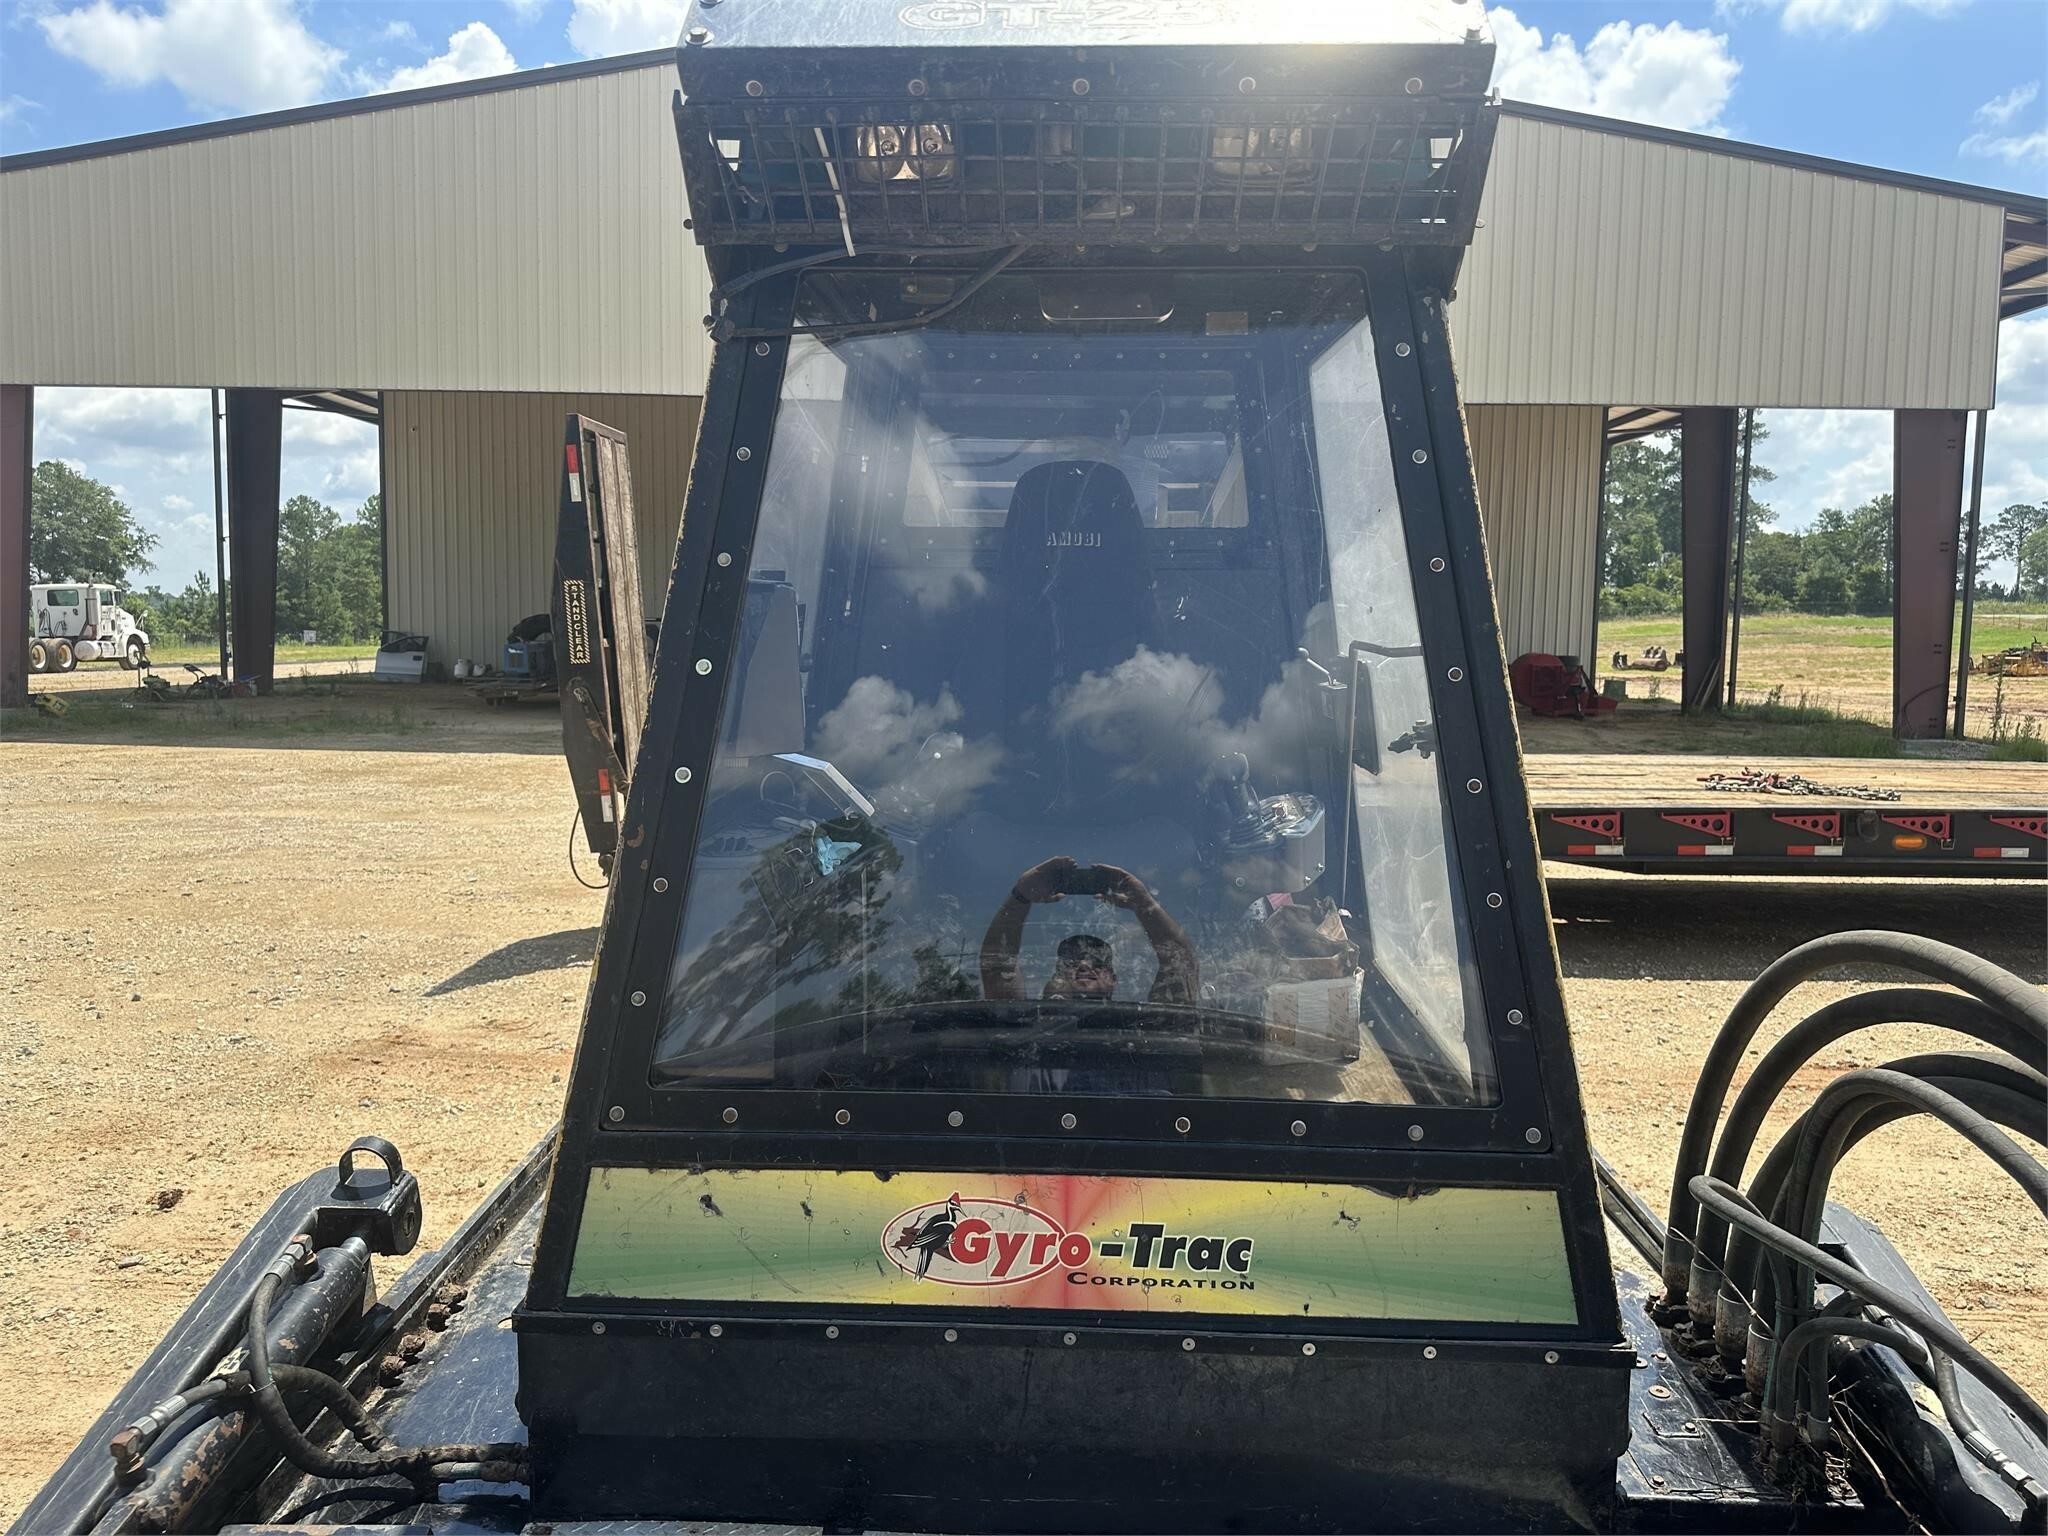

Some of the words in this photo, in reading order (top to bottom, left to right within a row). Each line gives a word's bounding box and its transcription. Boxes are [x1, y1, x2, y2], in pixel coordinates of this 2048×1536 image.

[571, 585, 580, 620] STAND
[574, 624, 584, 658] CLEAR
[949, 1218, 1255, 1277] Gyro-Trac
[1066, 1271, 1256, 1291] CORPORATION
